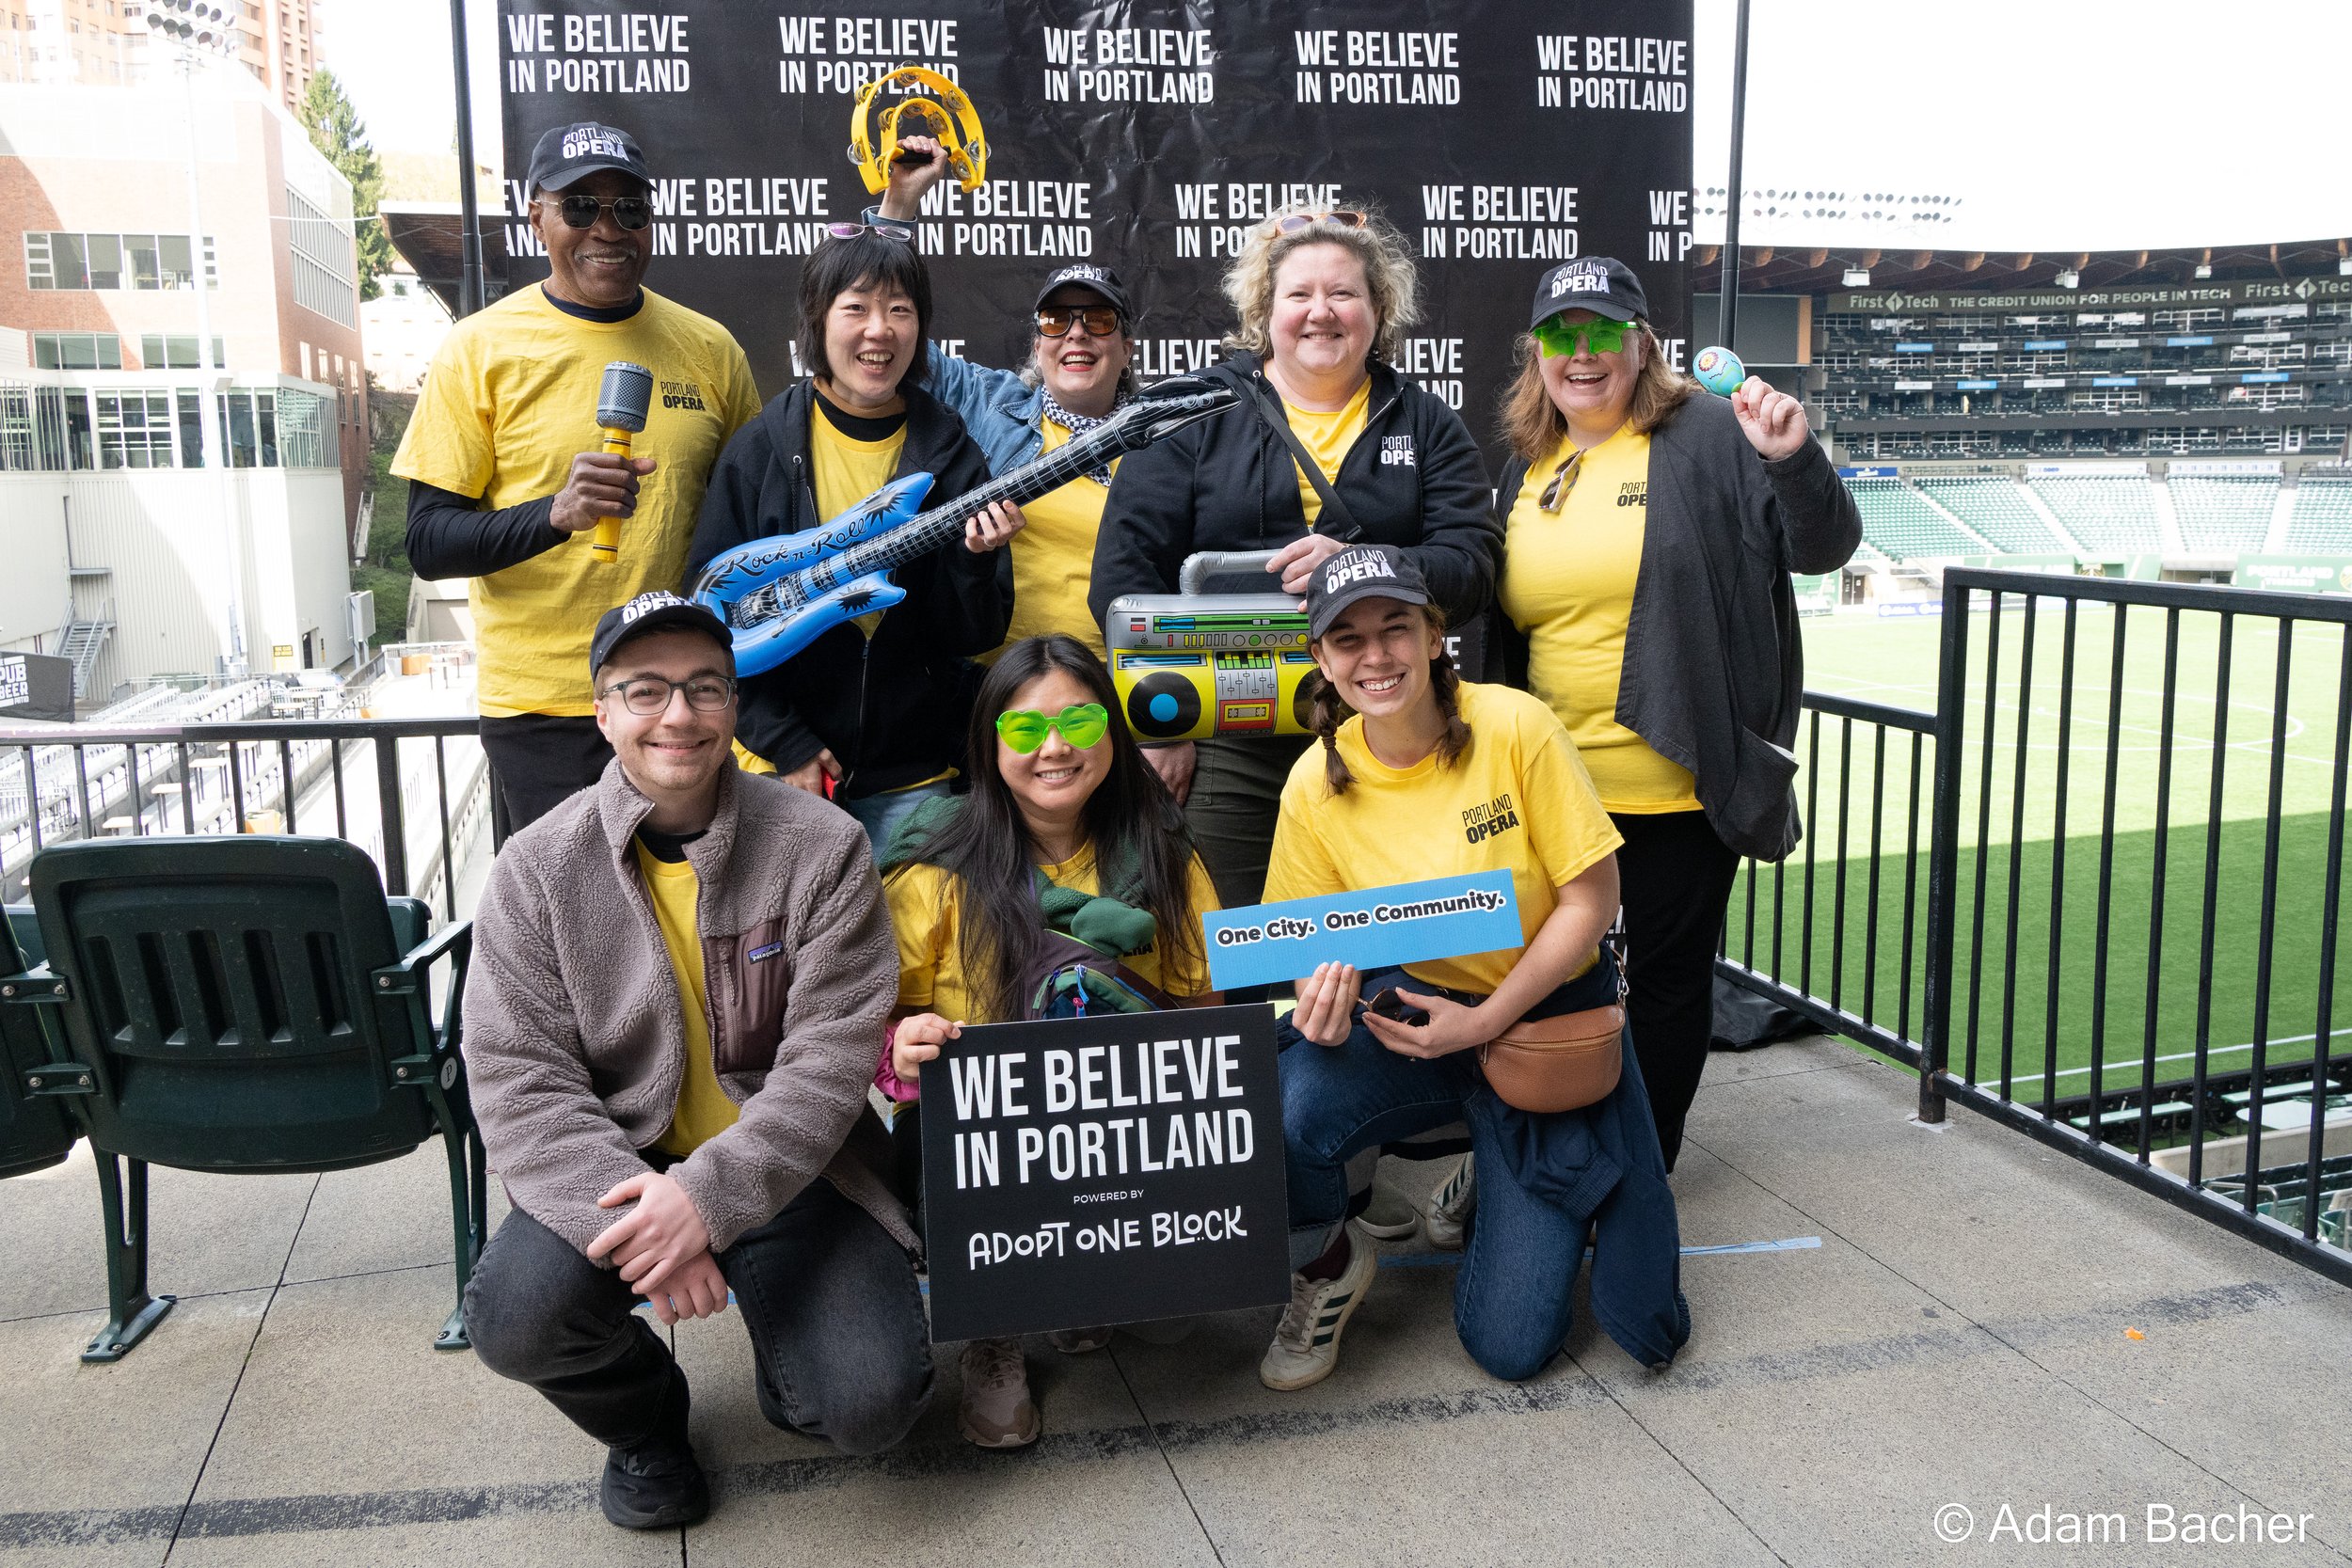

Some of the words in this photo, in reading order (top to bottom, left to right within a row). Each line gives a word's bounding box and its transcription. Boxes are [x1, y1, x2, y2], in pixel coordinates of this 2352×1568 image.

[507, 14, 555, 53] WE
[564, 14, 689, 53] BELIEVE
[779, 17, 826, 54] WE
[835, 18, 958, 56] BELIEVE
[1043, 27, 1089, 65] WE
[1097, 28, 1212, 67] BELIEVE
[1295, 31, 1338, 65] WE
[1347, 31, 1458, 68] BELIEVE
[1537, 36, 1578, 71] WE
[1590, 37, 1687, 76] BELIEVE
[509, 59, 535, 92] IN
[547, 58, 690, 92] PORTLAND
[780, 61, 805, 93] IN
[1045, 70, 1069, 102] IN
[1079, 70, 1214, 103] PORTLAND
[1297, 71, 1321, 103] IN
[1330, 72, 1459, 105] PORTLAND
[1538, 77, 1561, 107] IN
[1570, 78, 1687, 113] PORTLAND
[563, 139, 630, 162] OPERA
[564, 127, 624, 145] PORTLAND
[649, 179, 696, 215] WE
[706, 179, 829, 215] BELIEVE
[920, 179, 963, 216] WE
[974, 180, 1091, 219] BELIEVE
[1175, 183, 1219, 219] WE
[1422, 185, 1465, 220] WE
[1473, 186, 1579, 223] BELIEVE
[1649, 191, 1688, 225] WE
[652, 223, 676, 255] IN
[918, 223, 944, 255] IN
[955, 223, 1092, 257] PORTLAND
[1176, 227, 1200, 258] IN
[1422, 228, 1445, 258] IN
[1455, 228, 1579, 259] PORTLAND
[1648, 231, 1670, 261] IN
[1551, 275, 1610, 298] OPERA
[1552, 261, 1608, 282] PORTLAND
[1850, 295, 1883, 309] First
[1904, 294, 1939, 308] Tech
[1949, 297, 1975, 308] THE
[1978, 295, 2026, 307] CREDIT
[2030, 294, 2075, 306] UNION
[2079, 293, 2108, 304] FOR
[2112, 291, 2168, 303] PEOPLE
[2171, 290, 2186, 301] IN
[2190, 288, 2231, 300] TECH
[2246, 283, 2291, 297] First
[2318, 280, 2352, 293] Tec
[660, 381, 701, 397] PORTLAND
[662, 394, 706, 411] OPERA
[1380, 449, 1416, 466] OPE
[1382, 435, 1414, 451] PORTL
[1616, 493, 1647, 507] OPE
[1620, 482, 1646, 494] PORT
[1327, 549, 1387, 578] PORTLAND
[1327, 562, 1396, 594] OPERA
[1462, 794, 1513, 827] PORTLAND
[1466, 810, 1520, 845] OPERA
[1217, 927, 1261, 945] One
[1266, 917, 1315, 939] City.
[1326, 912, 1369, 929] One
[1375, 891, 1504, 923] Community.
[445, 1064, 453, 1083] P
[950, 1053, 1029, 1120] WE
[1044, 1035, 1244, 1114] BELIEVE
[955, 1131, 1000, 1190] IN
[1018, 1108, 1254, 1184] PORTLAND
[1073, 1191, 1128, 1204] POWERED
[1130, 1189, 1144, 1199] BY
